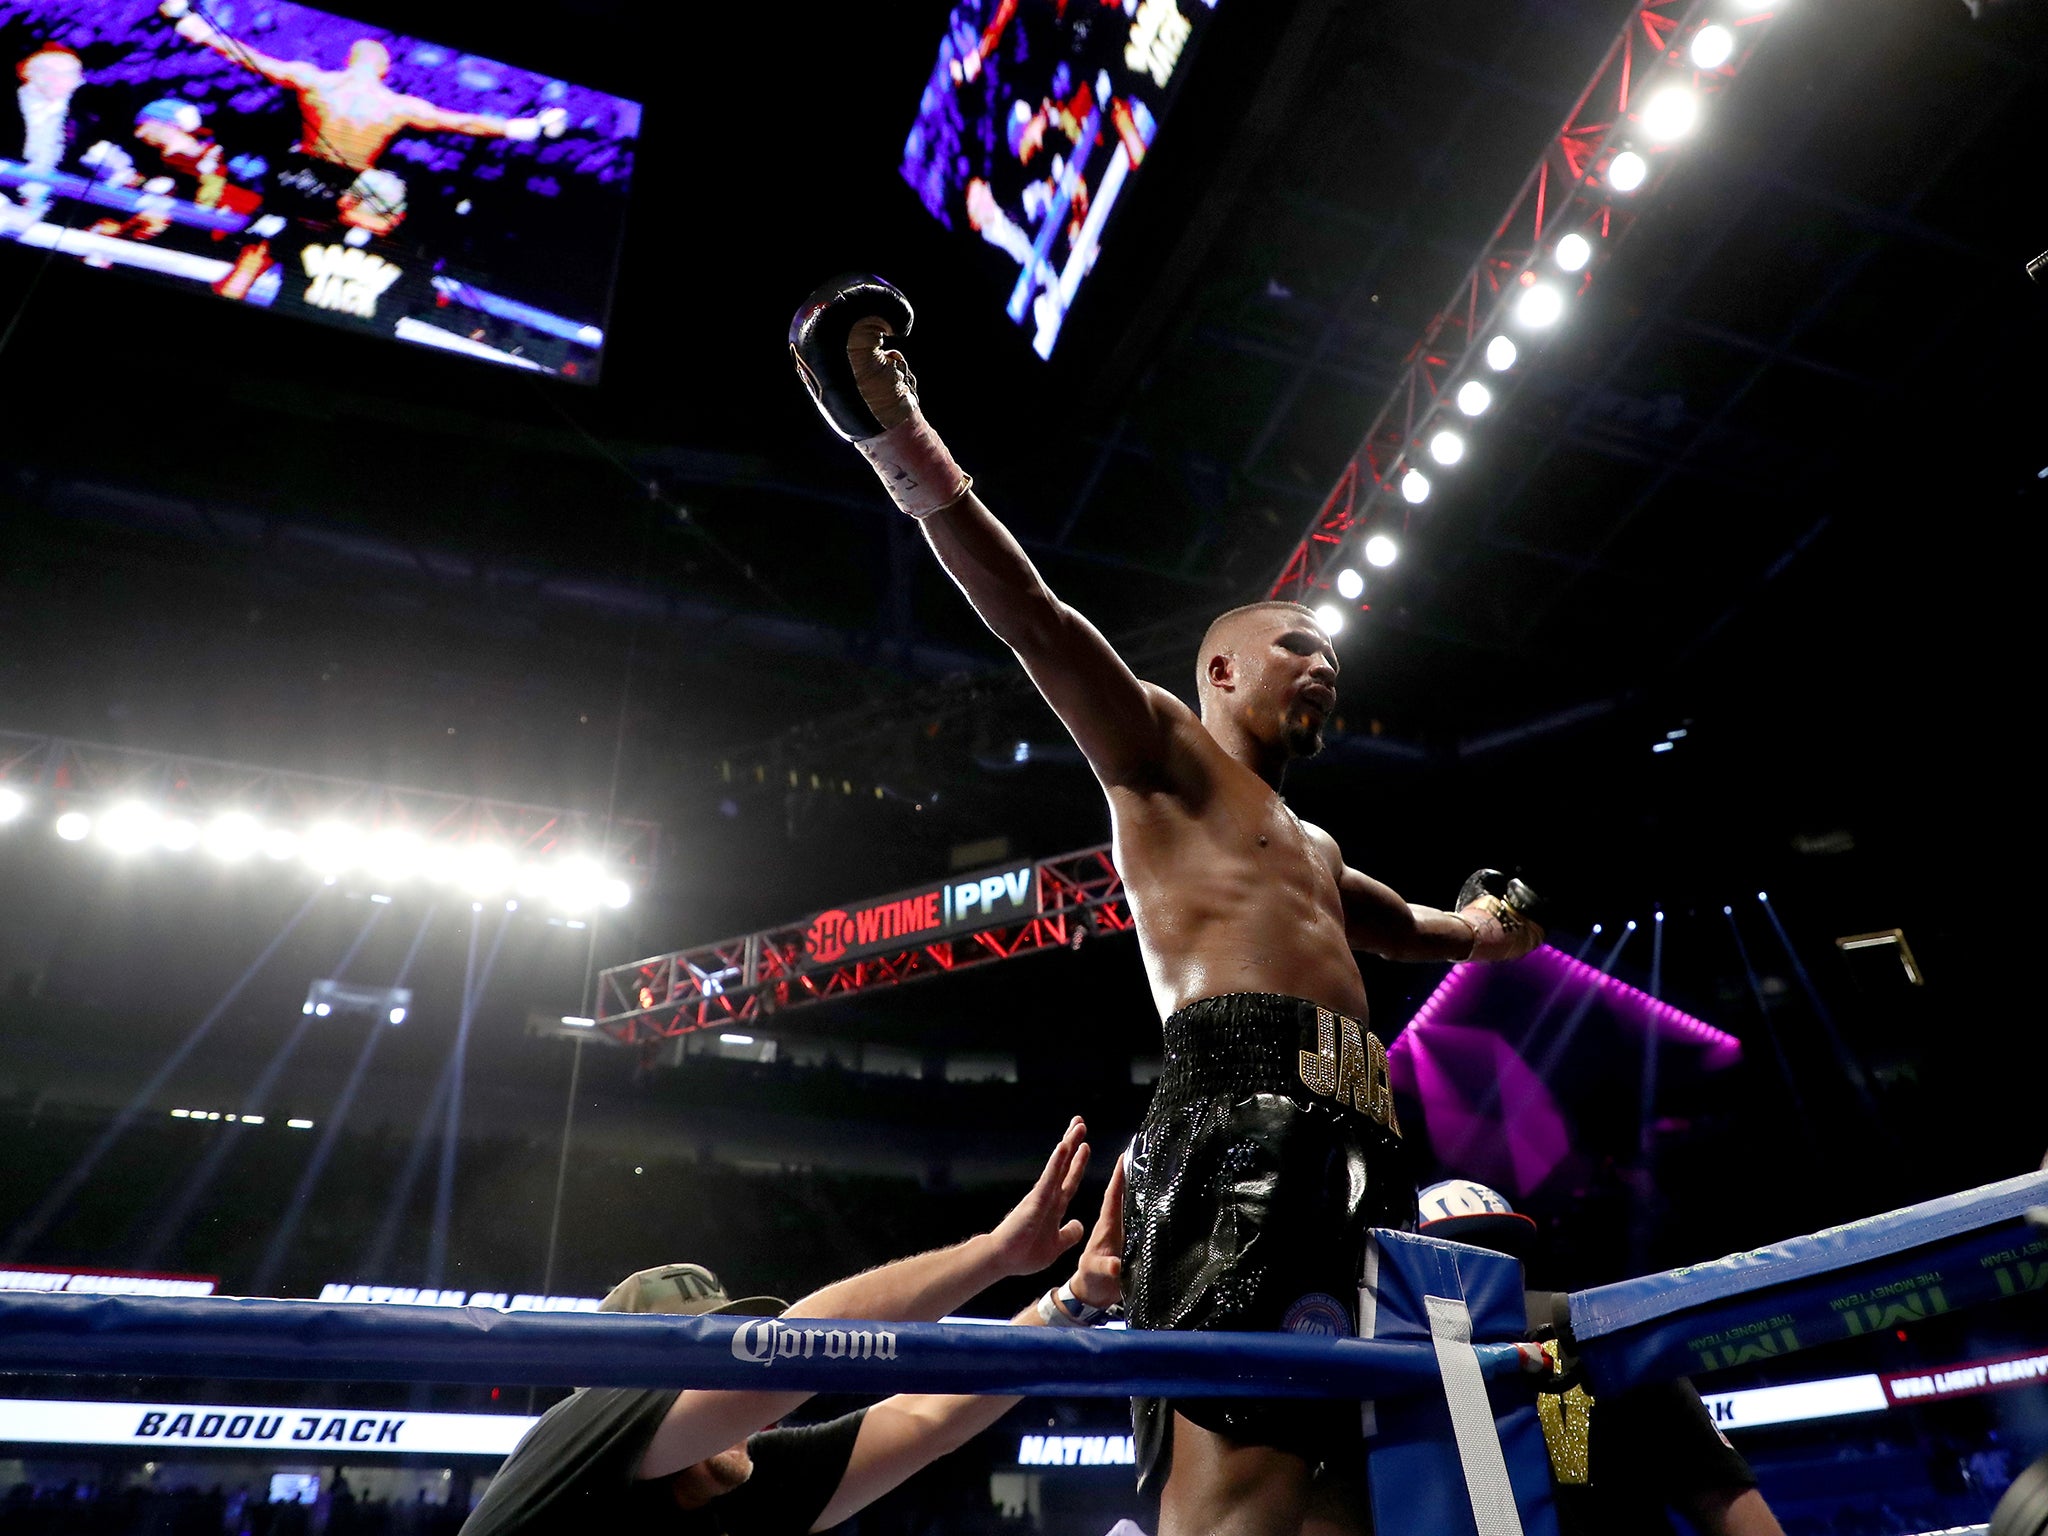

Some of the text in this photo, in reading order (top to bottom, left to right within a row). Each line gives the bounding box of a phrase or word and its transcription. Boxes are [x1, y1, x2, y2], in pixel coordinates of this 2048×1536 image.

[805, 868, 1031, 963] SHOWTIME PPV
[1979, 1239, 2048, 1268] NEY TEAM
[1829, 1271, 1945, 1312] THE MONEY TEAM
[731, 1318, 899, 1368] Corona
[1688, 1313, 1797, 1352] THE MONEY TEAM
[135, 1412, 405, 1443] BADOU JACK
